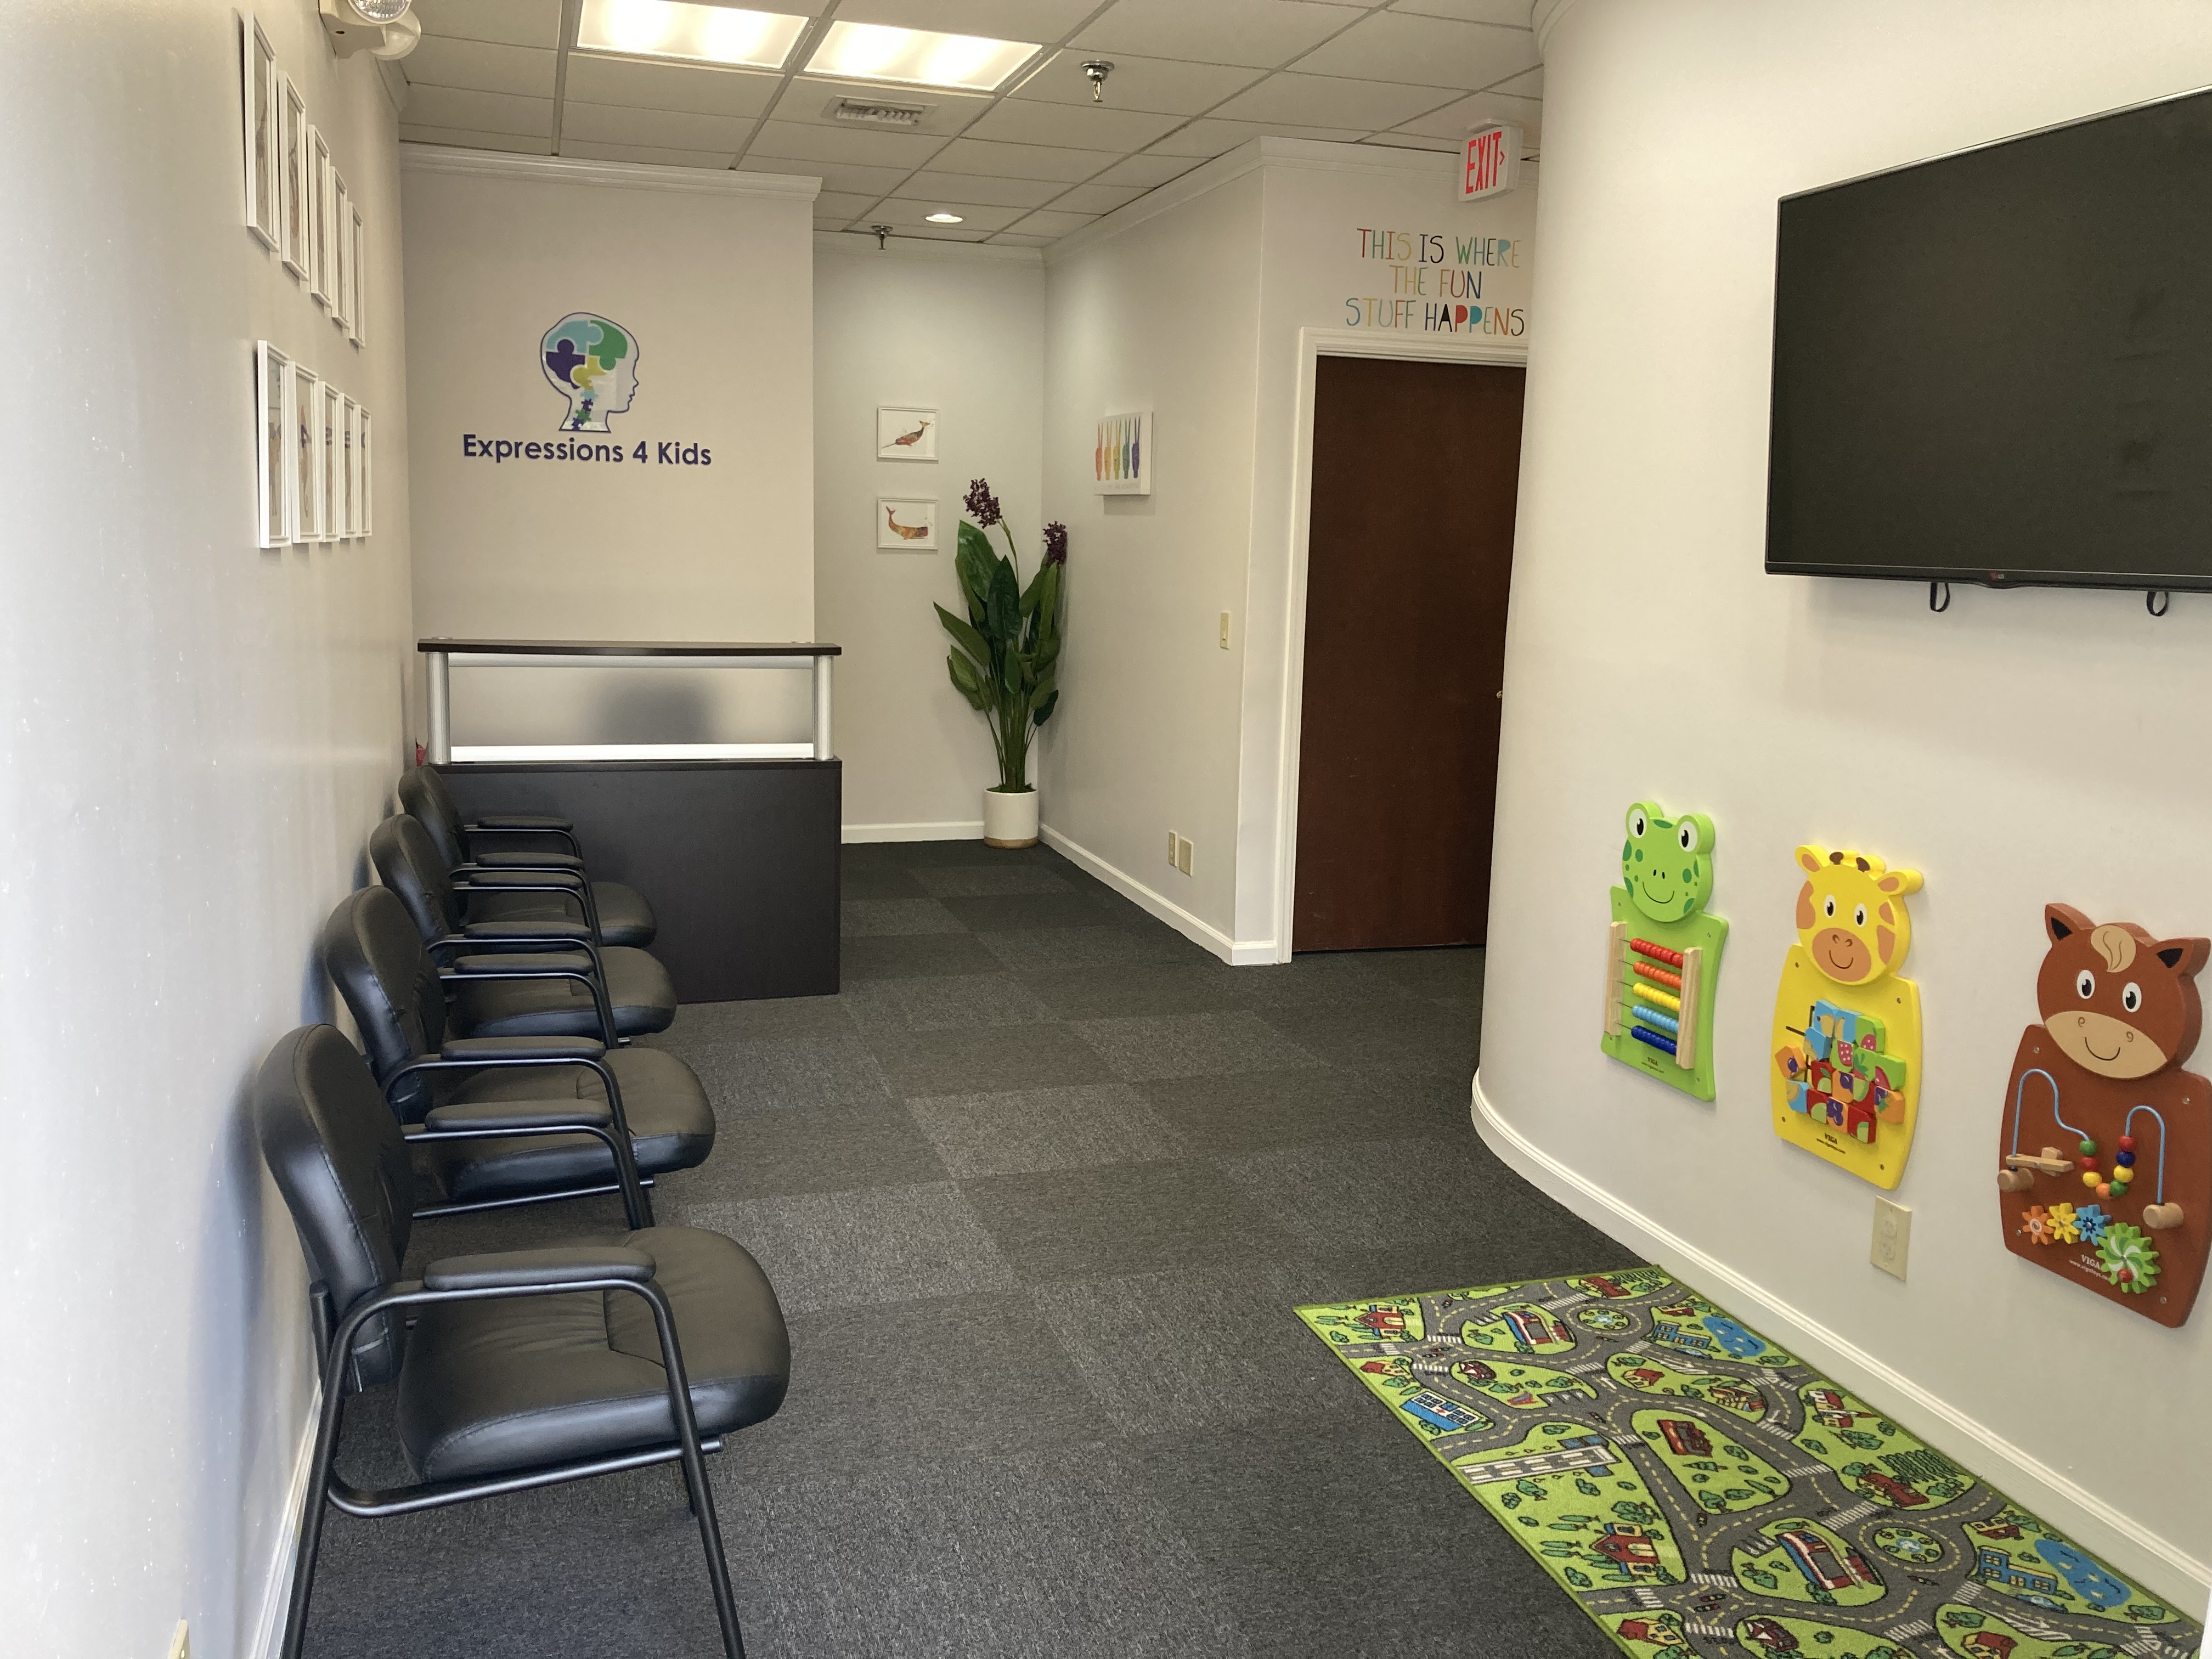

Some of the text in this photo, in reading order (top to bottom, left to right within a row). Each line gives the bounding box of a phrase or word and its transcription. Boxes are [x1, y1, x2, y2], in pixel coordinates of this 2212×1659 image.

[1466, 131, 1502, 194] EXIT
[1357, 228, 1522, 268] THIS IS WHERE
[1389, 264, 1482, 300] THE FUN
[1346, 297, 1525, 337] STUFF HAPPENS
[463, 434, 712, 466] Expressions 4 Kids
[2081, 1254, 2101, 1269] VIGA
